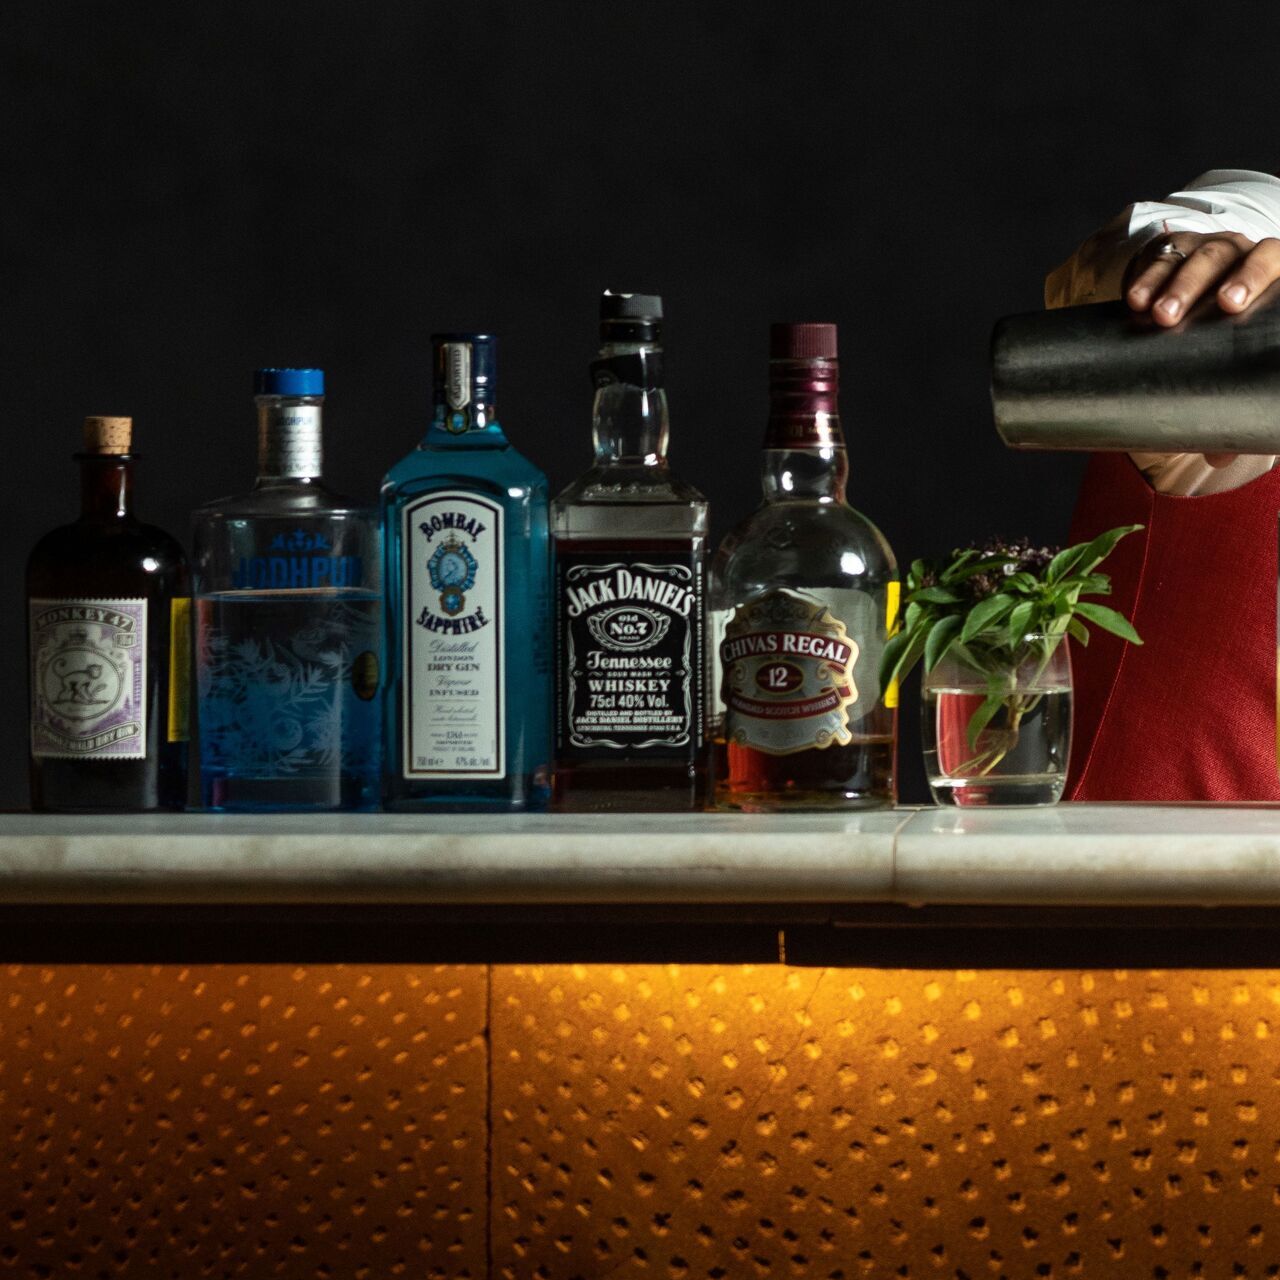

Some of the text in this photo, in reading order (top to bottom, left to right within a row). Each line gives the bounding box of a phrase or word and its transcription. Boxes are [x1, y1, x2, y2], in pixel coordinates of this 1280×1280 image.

[419, 512, 486, 543] BOMBAY
[565, 569, 697, 618] JACK DANIEL'S
[38, 607, 132, 629] MONKEY 47
[416, 606, 490, 635] SAPPHIRE
[618, 614, 639, 623] Old
[609, 622, 649, 636] No.7
[723, 634, 848, 664] CHIVAS REGAL
[427, 663, 480, 672] DRY GIN
[586, 650, 673, 670] Tennessee
[587, 679, 672, 693] WHISKEY
[768, 667, 789, 688] 12
[589, 694, 670, 708] 75cl 40% Vol.
